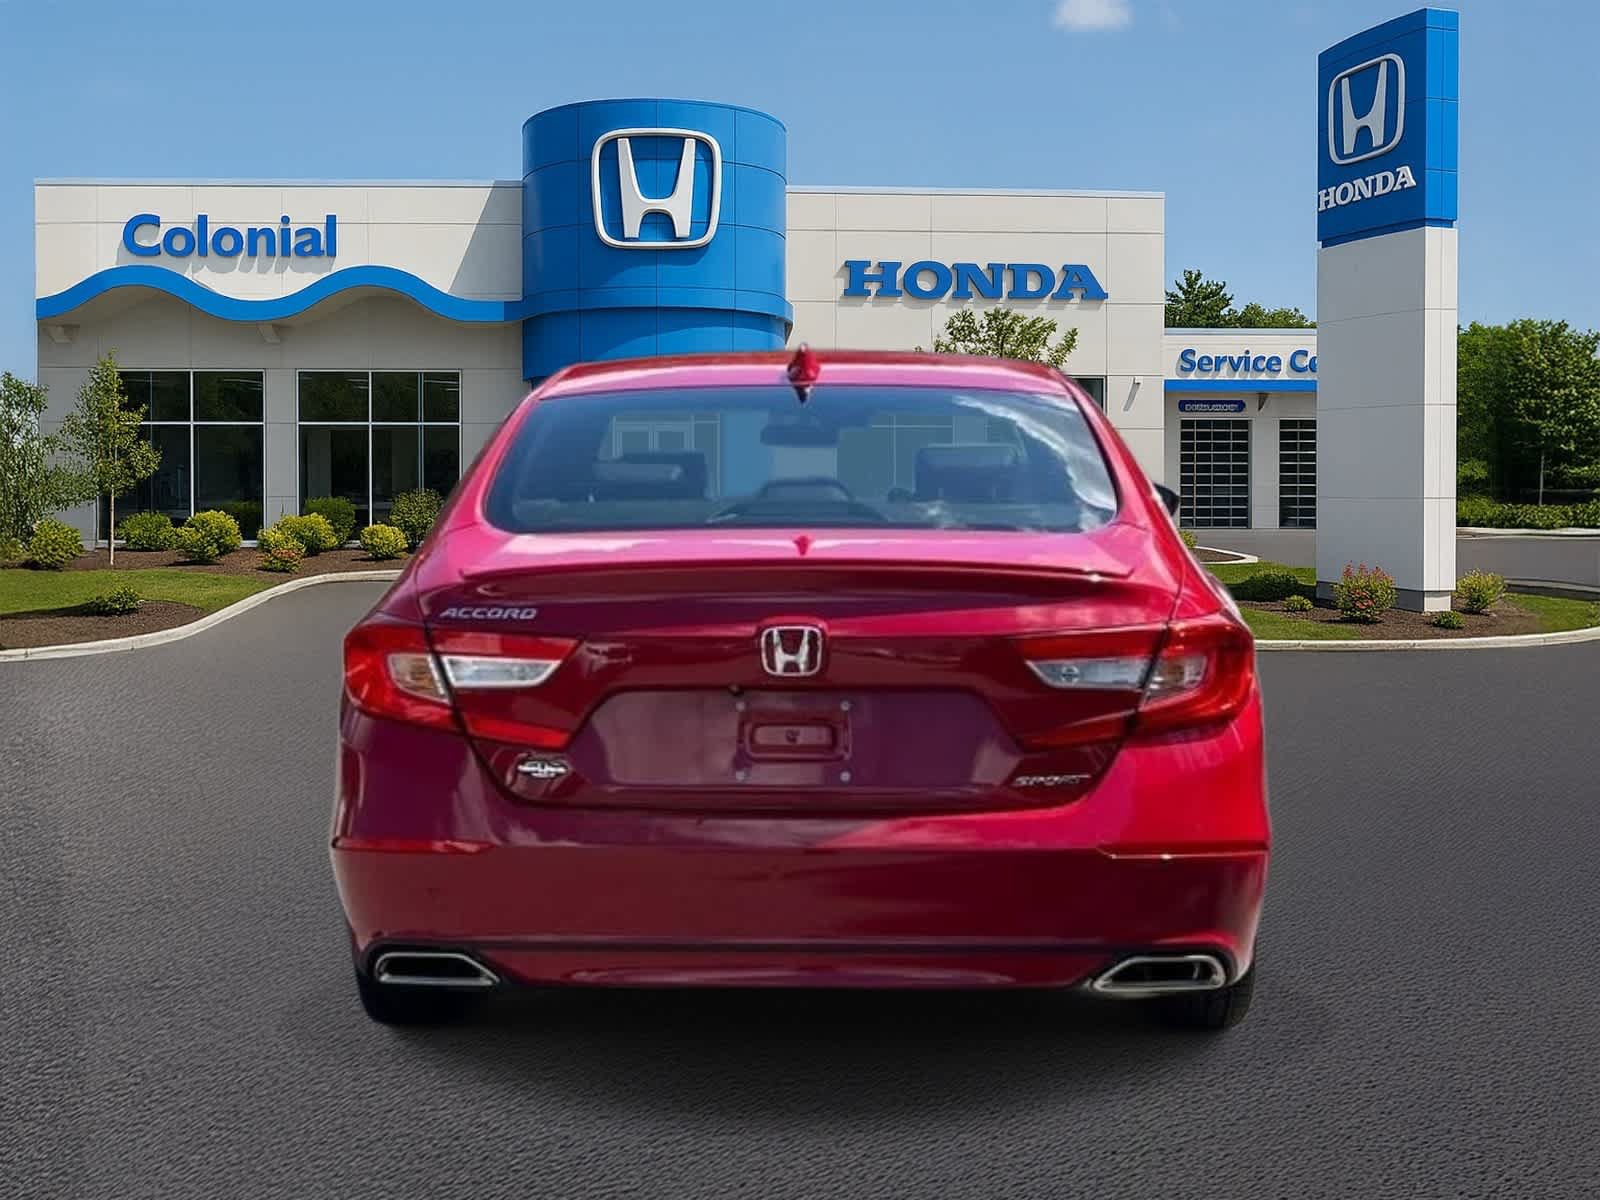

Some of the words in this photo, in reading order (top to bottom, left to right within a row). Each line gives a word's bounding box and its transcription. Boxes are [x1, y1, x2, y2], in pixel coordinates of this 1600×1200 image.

[1318, 165, 1416, 212] HONDA
[122, 213, 337, 257] Colonial
[843, 260, 1109, 299] HONDA
[1180, 348, 1281, 372] Service
[440, 607, 537, 619] ACCORD
